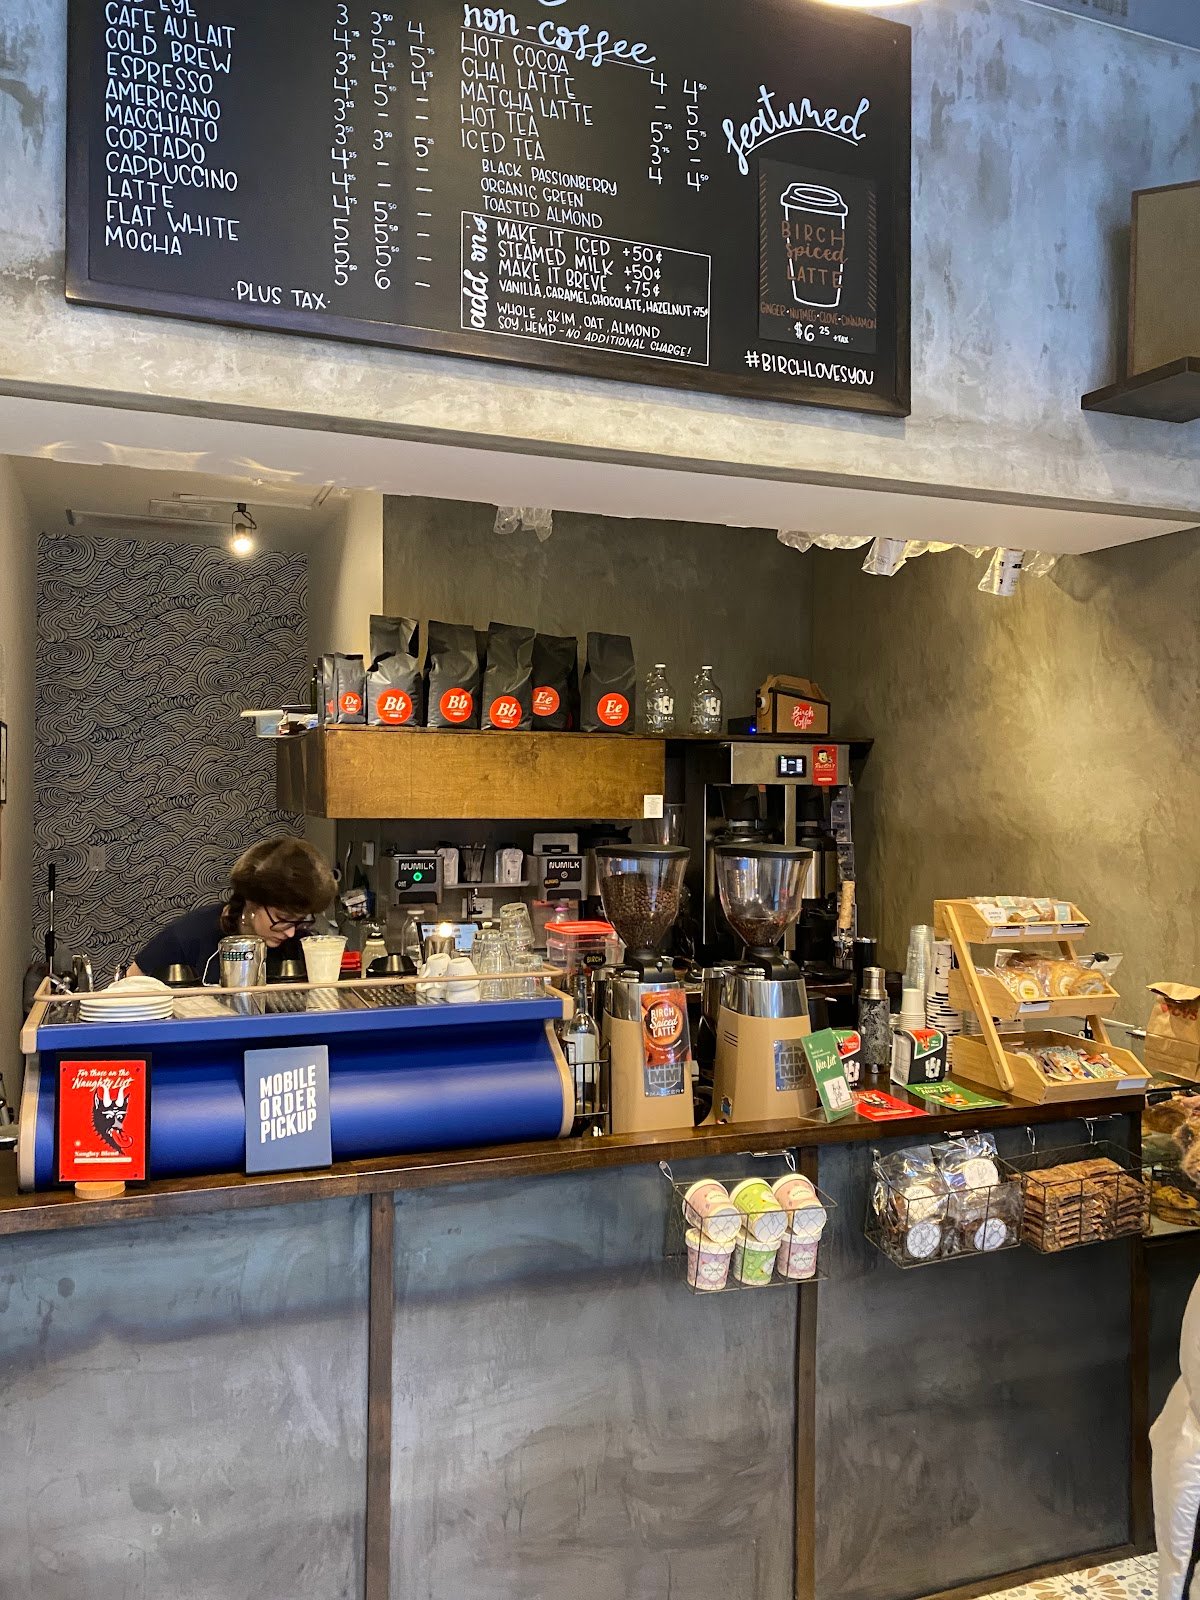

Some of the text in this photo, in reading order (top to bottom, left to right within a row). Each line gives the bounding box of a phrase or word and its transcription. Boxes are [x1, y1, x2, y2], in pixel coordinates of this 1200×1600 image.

[105, 2, 235, 49] CAFE AU LAIT
[337, 4, 349, 25] 3
[408, 21, 425, 43] 4
[105, 27, 232, 74] COLD BREW
[461, 32, 568, 74] HOT COCOA
[107, 51, 213, 94] ESPRESSO
[462, 57, 575, 99] CHAI LATTE
[650, 72, 667, 94] 4
[106, 78, 221, 121] AMERICANO
[461, 80, 593, 126] MATCHA LATTE
[687, 105, 699, 125] 5
[106, 104, 218, 142] MACCHIATO
[460, 104, 539, 137] HOT TEA
[723, 85, 869, 175] featured
[105, 126, 205, 163] CORTADO
[461, 129, 545, 161] ICED TEA
[105, 151, 237, 191] CAPPUCCINO
[482, 159, 617, 196] BLACK PASSIONBERRY
[649, 167, 663, 184] 4
[108, 176, 173, 208] LATTE
[481, 177, 583, 208] ORGANIC GREEN
[106, 200, 240, 241] FLAT WHITE
[482, 195, 602, 228] TOASTED ALMOND
[105, 225, 182, 255] MOCHA
[333, 218, 349, 240] 5
[497, 221, 537, 244] MAKE
[549, 231, 565, 248] IT
[575, 238, 610, 256] ICED
[782, 220, 845, 247] BIRCH
[334, 242, 350, 264] 5
[498, 240, 566, 266] STEAMED
[575, 254, 613, 276] MILK
[785, 241, 848, 266] spiced
[374, 269, 390, 289] 6
[498, 259, 540, 282] MAKE
[549, 267, 560, 285] IT
[566, 269, 607, 293] BREVE
[787, 264, 843, 288] LATTE
[646, 302, 692, 317] HAZELNUT
[525, 322, 556, 336] HEMP
[566, 329, 581, 338] NO
[584, 332, 646, 350] ADDITIONAL
[650, 341, 691, 358] CHARGE!
[611, 322, 660, 338] ALMOND
[744, 350, 874, 385] #BIRCHLOVESYOU
[344, 696, 358, 705] De
[383, 696, 406, 711] Bb
[447, 695, 468, 709] Bb
[496, 703, 517, 717] Bb
[535, 691, 553, 705] Ee
[605, 700, 623, 713] Ee
[401, 862, 435, 871] NUMILK
[549, 861, 580, 869] NUMILK
[650, 1014, 678, 1030] Spiced
[651, 1007, 674, 1018] BIRCH
[653, 1026, 675, 1038] LATTE
[72, 1077, 134, 1092] Naughty List
[77, 1069, 89, 1077] For
[90, 1068, 107, 1077] those
[118, 1068, 130, 1077] the
[260, 1065, 316, 1099] MOBILE
[260, 1086, 316, 1120] ORDER
[260, 1108, 317, 1144] PICKUP
